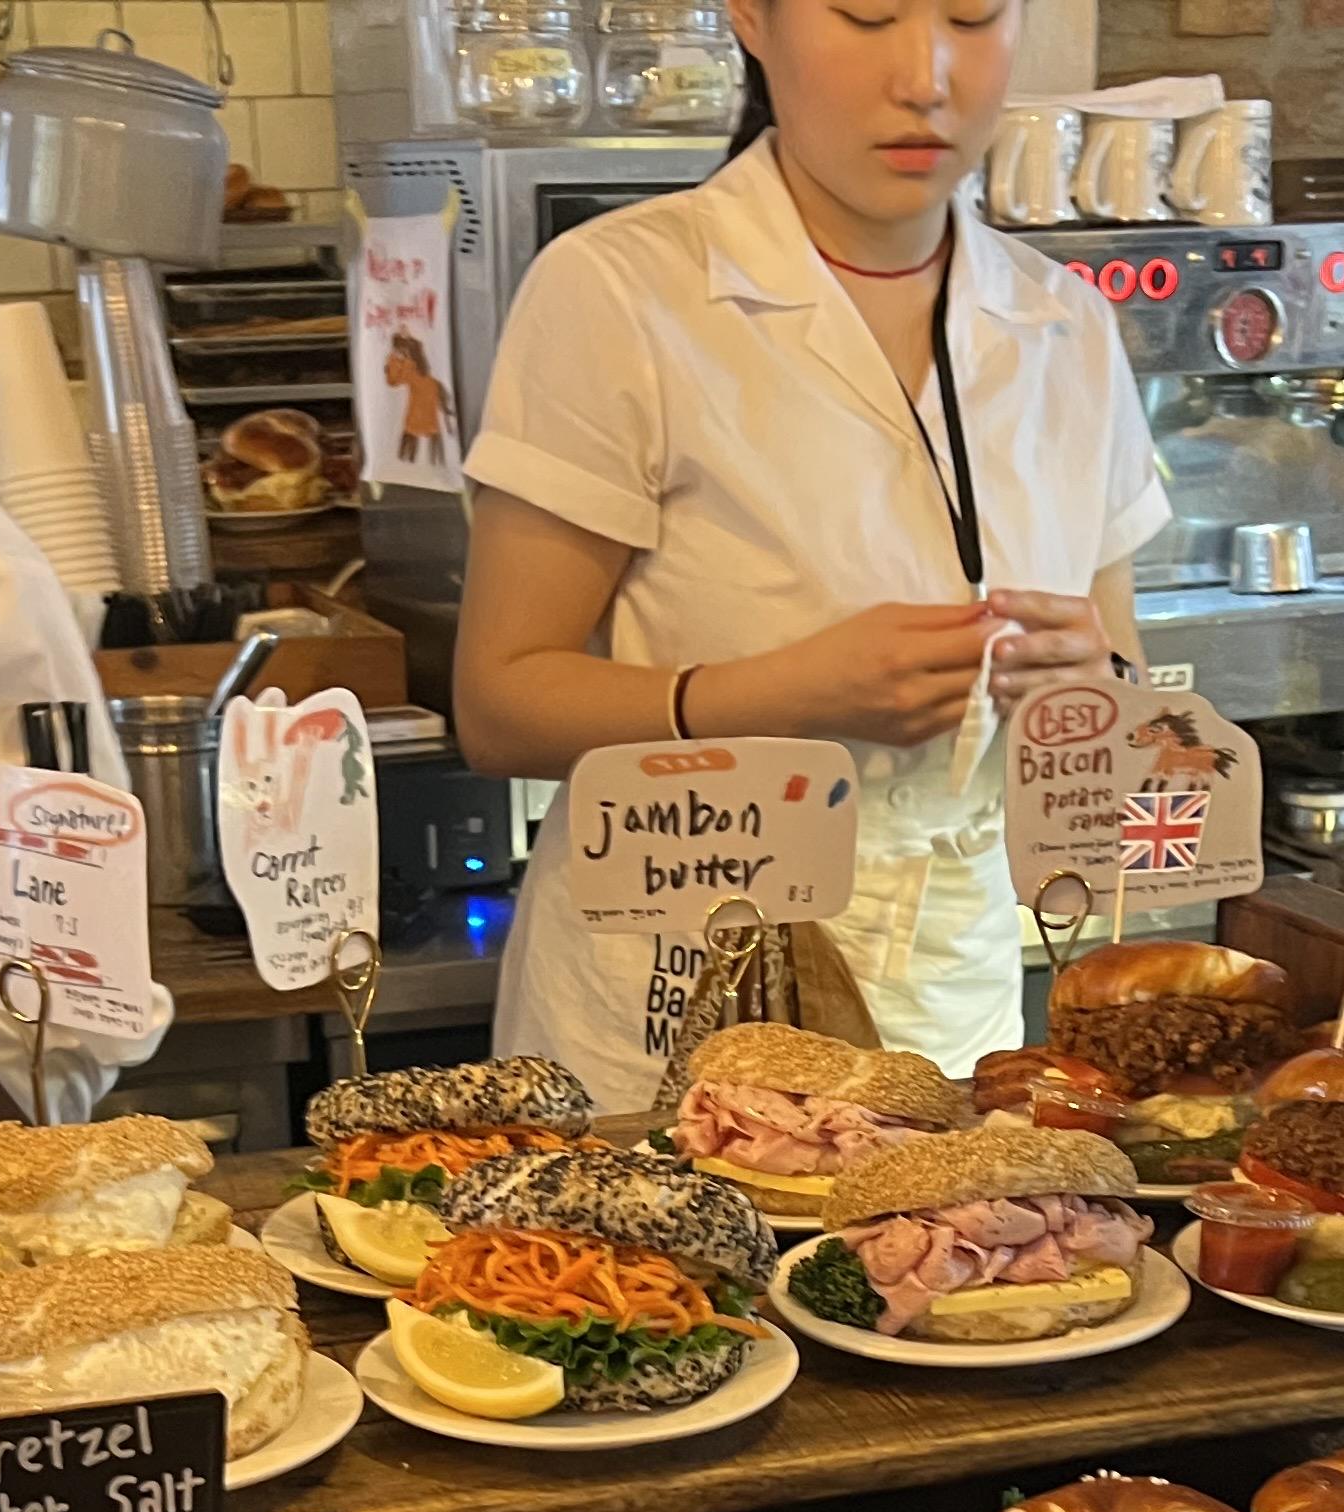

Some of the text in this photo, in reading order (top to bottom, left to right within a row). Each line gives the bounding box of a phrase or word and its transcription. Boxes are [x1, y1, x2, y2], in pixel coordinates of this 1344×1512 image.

[1038, 703, 1102, 740] BEST
[1019, 745, 1113, 786] Bacon
[1043, 787, 1114, 818] potato
[583, 789, 762, 861] jambon
[13, 859, 69, 906] Lane
[644, 853, 776, 896] butter
